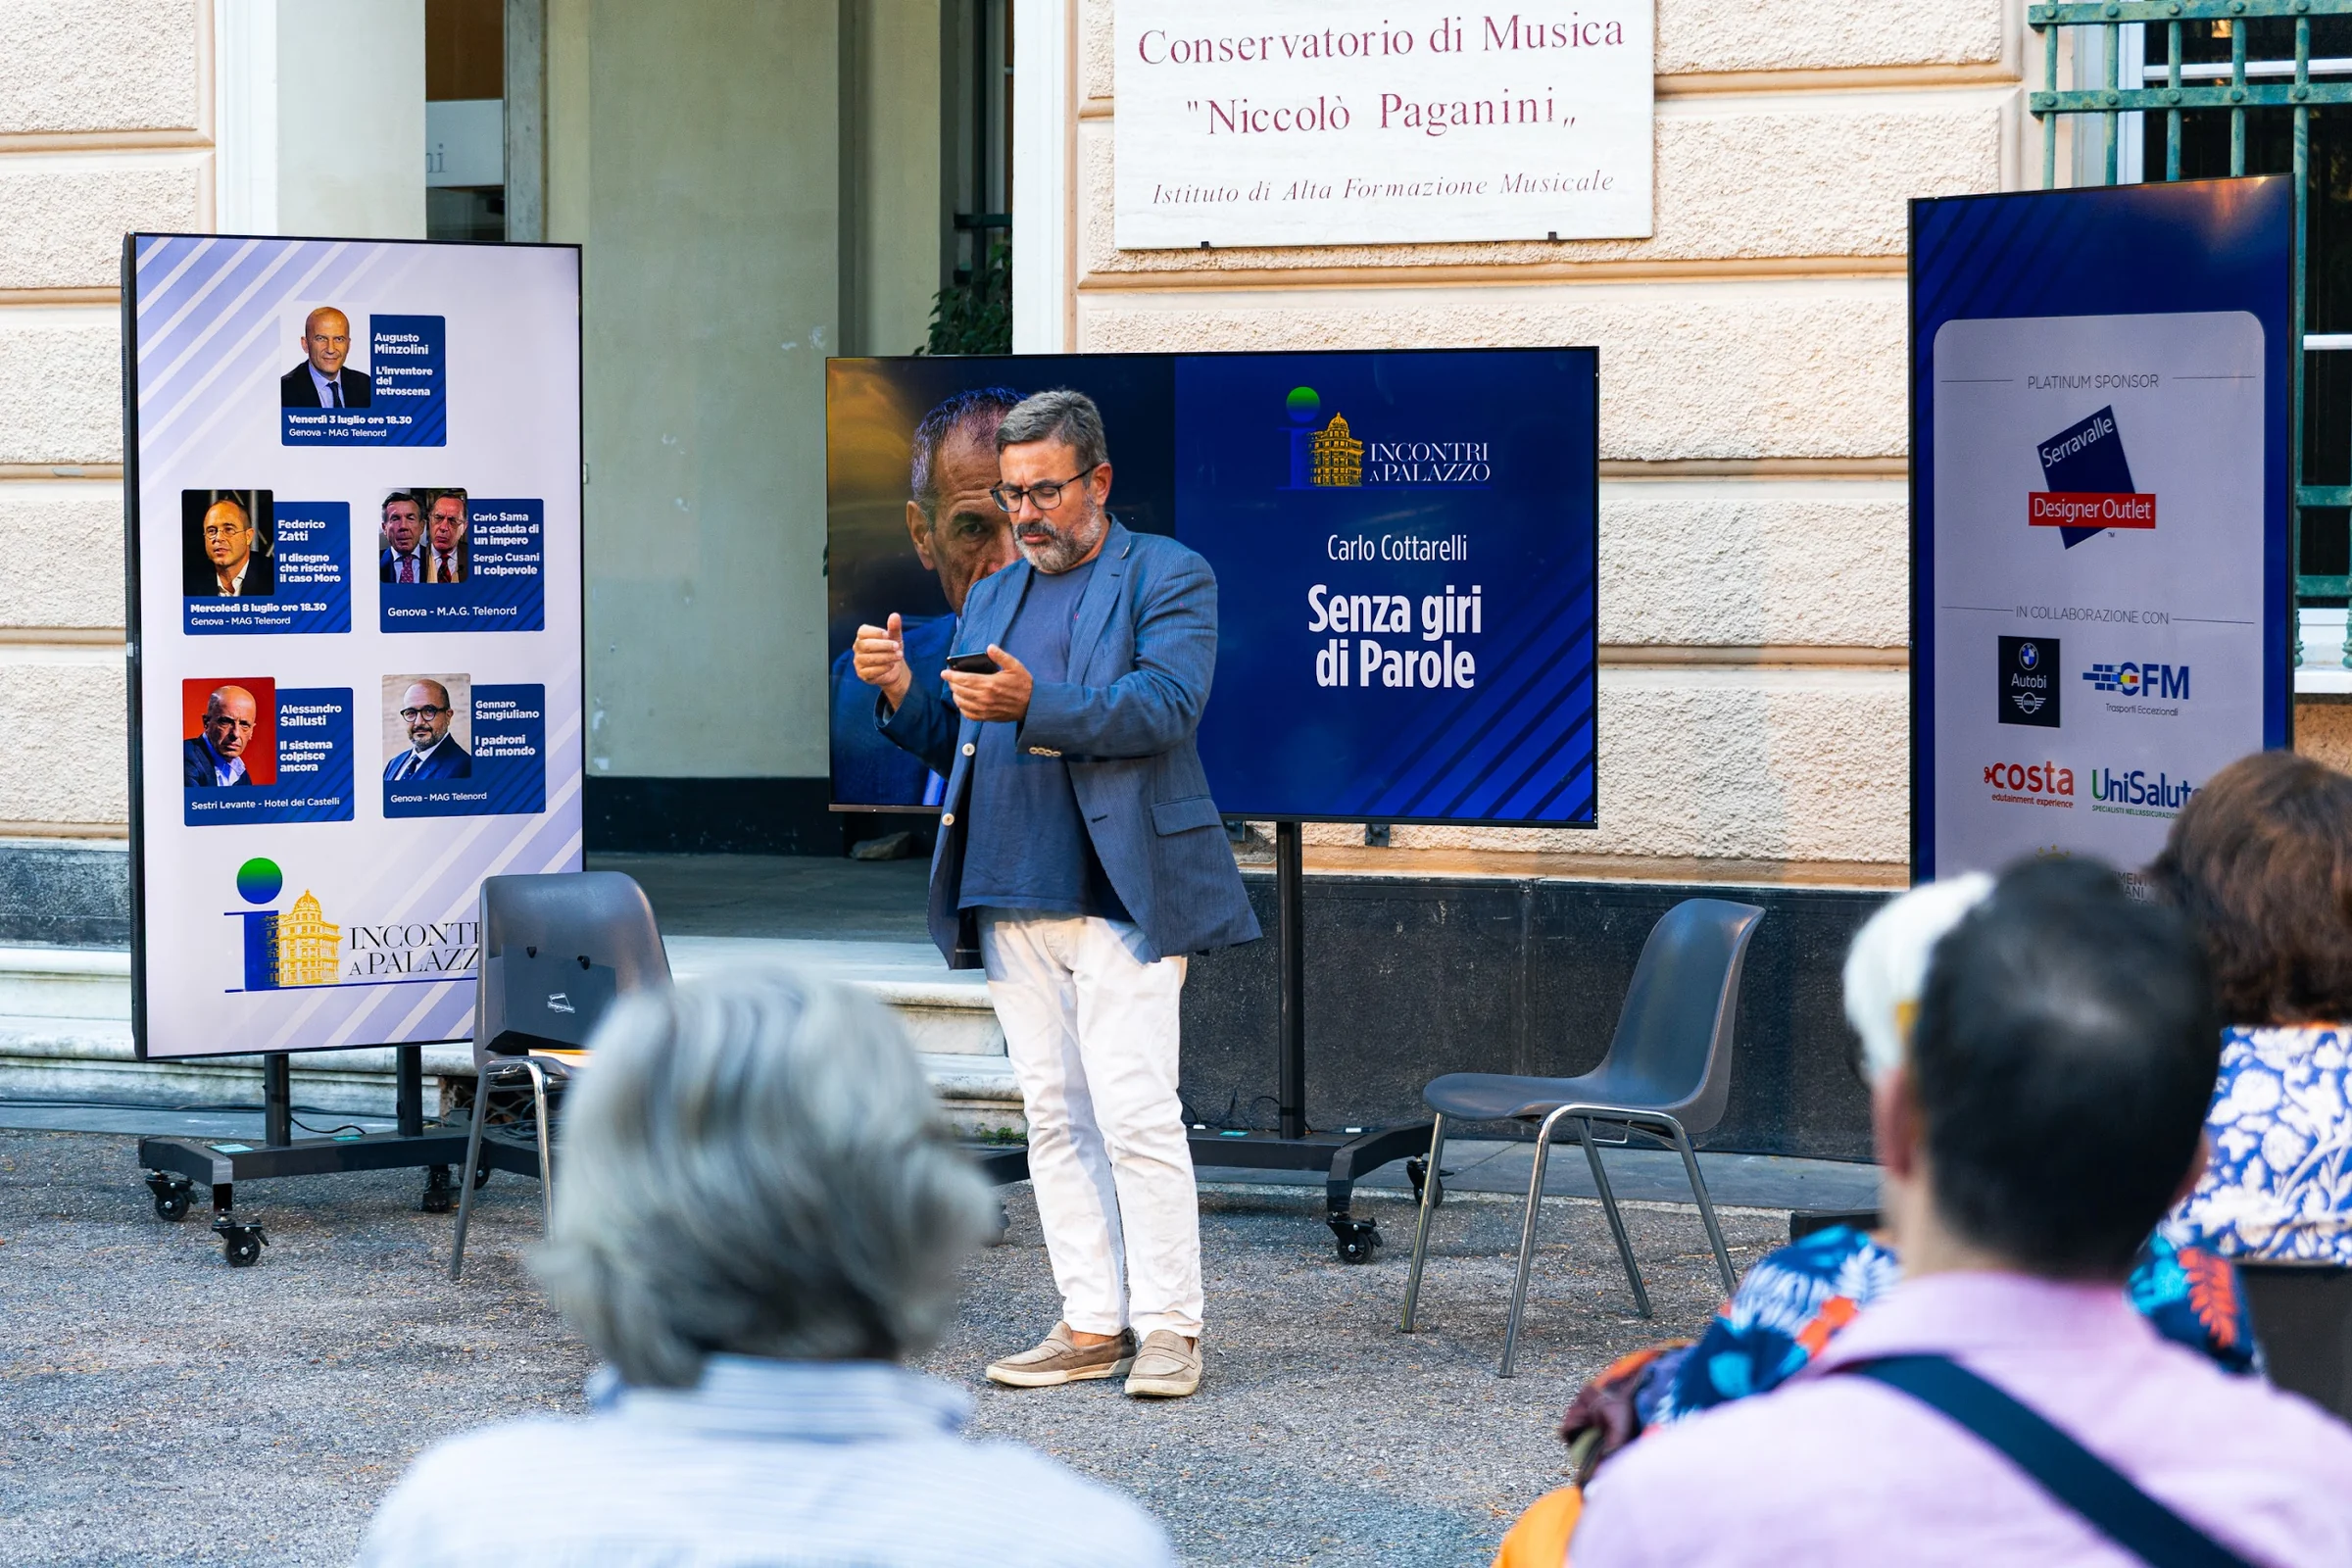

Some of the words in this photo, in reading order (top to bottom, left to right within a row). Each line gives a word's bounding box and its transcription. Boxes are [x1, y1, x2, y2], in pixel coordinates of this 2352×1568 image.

[1138, 20, 1414, 66] Conservatorio
[1429, 17, 1463, 54] di
[1481, 12, 1625, 52] Musica
[1152, 182, 1239, 206] Istituto
[1249, 180, 1273, 203] di
[1283, 178, 1332, 202] Alta
[1343, 175, 1488, 199] Formazione
[1499, 170, 1615, 194] Musicale
[374, 332, 419, 343] Augusto
[374, 344, 429, 355] Minzolini
[375, 366, 433, 375] L'inventore
[375, 376, 392, 385] del
[2027, 375, 2091, 390] PLATINUM
[2094, 373, 2159, 389] SPONSOR
[375, 387, 431, 396] retroscena
[288, 415, 328, 424] Venerdì
[328, 416, 336, 424] 3
[337, 415, 366, 425] luglio
[385, 416, 413, 424] 18.30
[289, 428, 321, 437] Genova
[352, 428, 387, 437] Telenord
[2040, 416, 2115, 468] Serravalle
[1369, 441, 1490, 463] INCONTRI
[1383, 463, 1491, 483] PALAZZO
[2034, 497, 2100, 523] Designer
[2102, 499, 2151, 520] Outlet
[472, 514, 498, 522] Carlo
[499, 512, 529, 521] Sama
[277, 519, 325, 529] Federico
[473, 524, 487, 534] La
[489, 524, 527, 534] caduta
[528, 523, 539, 534] di
[277, 530, 309, 542] Zatti
[473, 537, 488, 546] un
[490, 536, 529, 547] impero
[1327, 534, 1376, 561] Carlo
[1381, 534, 1468, 561] Cottarelli
[279, 554, 286, 563] Il
[288, 553, 329, 564] disegno
[472, 554, 504, 564] Sergio
[505, 553, 540, 562] Cusani
[279, 564, 299, 573] che
[300, 564, 339, 572] riscrive
[473, 565, 481, 575] Il
[483, 565, 538, 576] colpevole
[279, 573, 287, 583] il
[314, 573, 342, 583] Moro
[190, 604, 241, 612] Mercoledì
[242, 604, 250, 612] 8
[251, 603, 280, 613] luglio
[300, 603, 327, 612] 18.30
[387, 607, 427, 616] Genova
[436, 607, 470, 616] M.A.G.
[472, 606, 517, 615] Telenord
[1307, 583, 1411, 633] Senza
[1421, 584, 1482, 642] giri
[2015, 605, 2028, 618] IN
[2030, 606, 2139, 624] COLLABORAZIONE
[2142, 611, 2169, 625] CON
[191, 617, 224, 626] Genova
[254, 616, 290, 625] Telenord
[1315, 638, 1349, 688] di
[1359, 639, 1476, 689] Parole
[2011, 672, 2046, 689] Autobi
[2120, 662, 2189, 700] CFM
[280, 704, 342, 714] Alessandro
[2105, 703, 2136, 714] Trasporti
[2137, 706, 2179, 716] Eccezionali
[280, 715, 327, 726] Sallusti
[475, 710, 540, 721] Sangiuliano
[279, 741, 287, 750] Il
[289, 740, 333, 750] sistema
[475, 736, 479, 746] I
[481, 734, 526, 747] padroni
[279, 751, 325, 762] colpisce
[475, 747, 494, 758] del
[495, 746, 536, 757] mondo
[279, 763, 318, 772] ancora
[1987, 760, 2074, 796] costa
[391, 794, 422, 803] Genova
[452, 792, 487, 801] Telenord
[1991, 794, 2034, 805] edutainment
[2035, 798, 2074, 808] experience
[191, 801, 218, 810] Sestri
[220, 800, 256, 809] Levante
[264, 799, 289, 808] Hotel
[290, 798, 305, 807] dei
[307, 797, 340, 807] Castelli
[2091, 805, 2125, 814] SPECIALISTI
[349, 921, 479, 951] INCONT
[349, 961, 362, 976] A
[367, 947, 479, 975] PALAZZ
